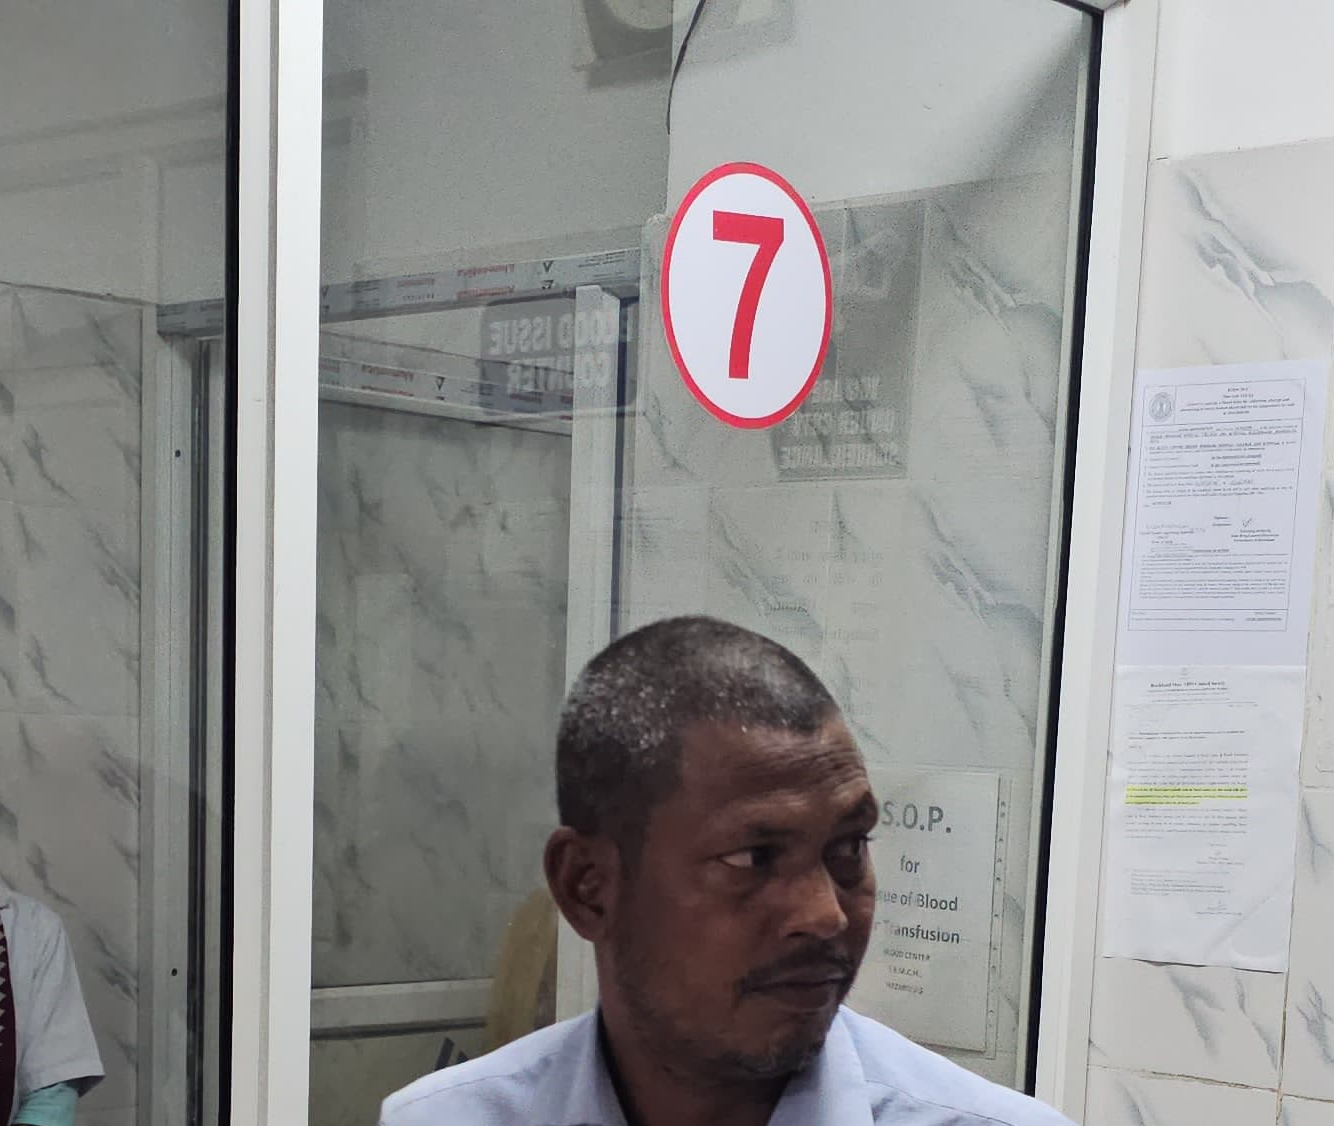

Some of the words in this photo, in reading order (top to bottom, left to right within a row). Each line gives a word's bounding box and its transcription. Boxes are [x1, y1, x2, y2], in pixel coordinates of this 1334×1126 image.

[712, 210, 784, 380] 7
[900, 855, 920, 873] for
[916, 893, 958, 911] Blood
